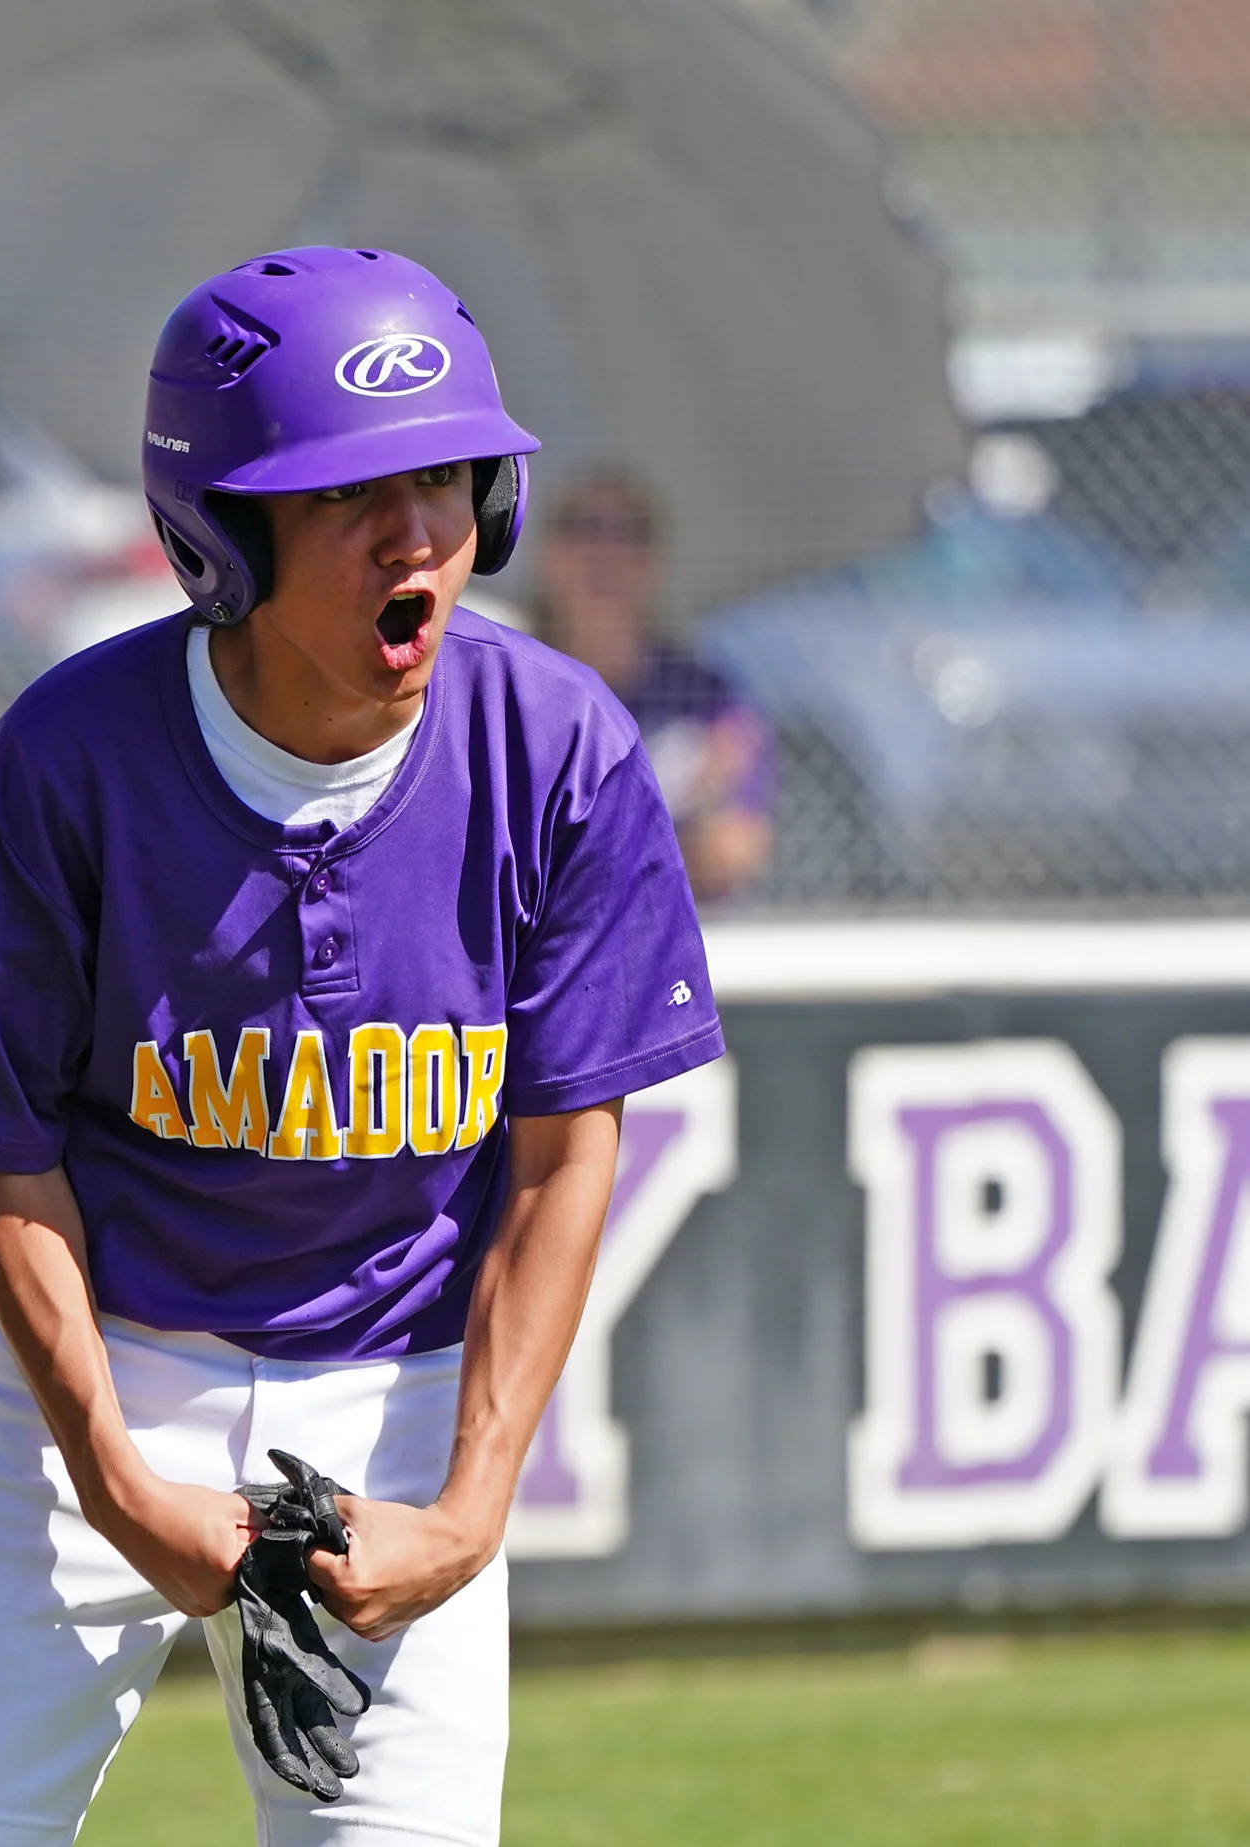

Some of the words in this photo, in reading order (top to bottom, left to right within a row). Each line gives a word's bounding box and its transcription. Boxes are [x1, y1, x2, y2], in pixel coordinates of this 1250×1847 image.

[353, 338, 436, 388] R
[146, 431, 191, 453] RAWLINGS
[128, 1022, 509, 1161] AMADOR
